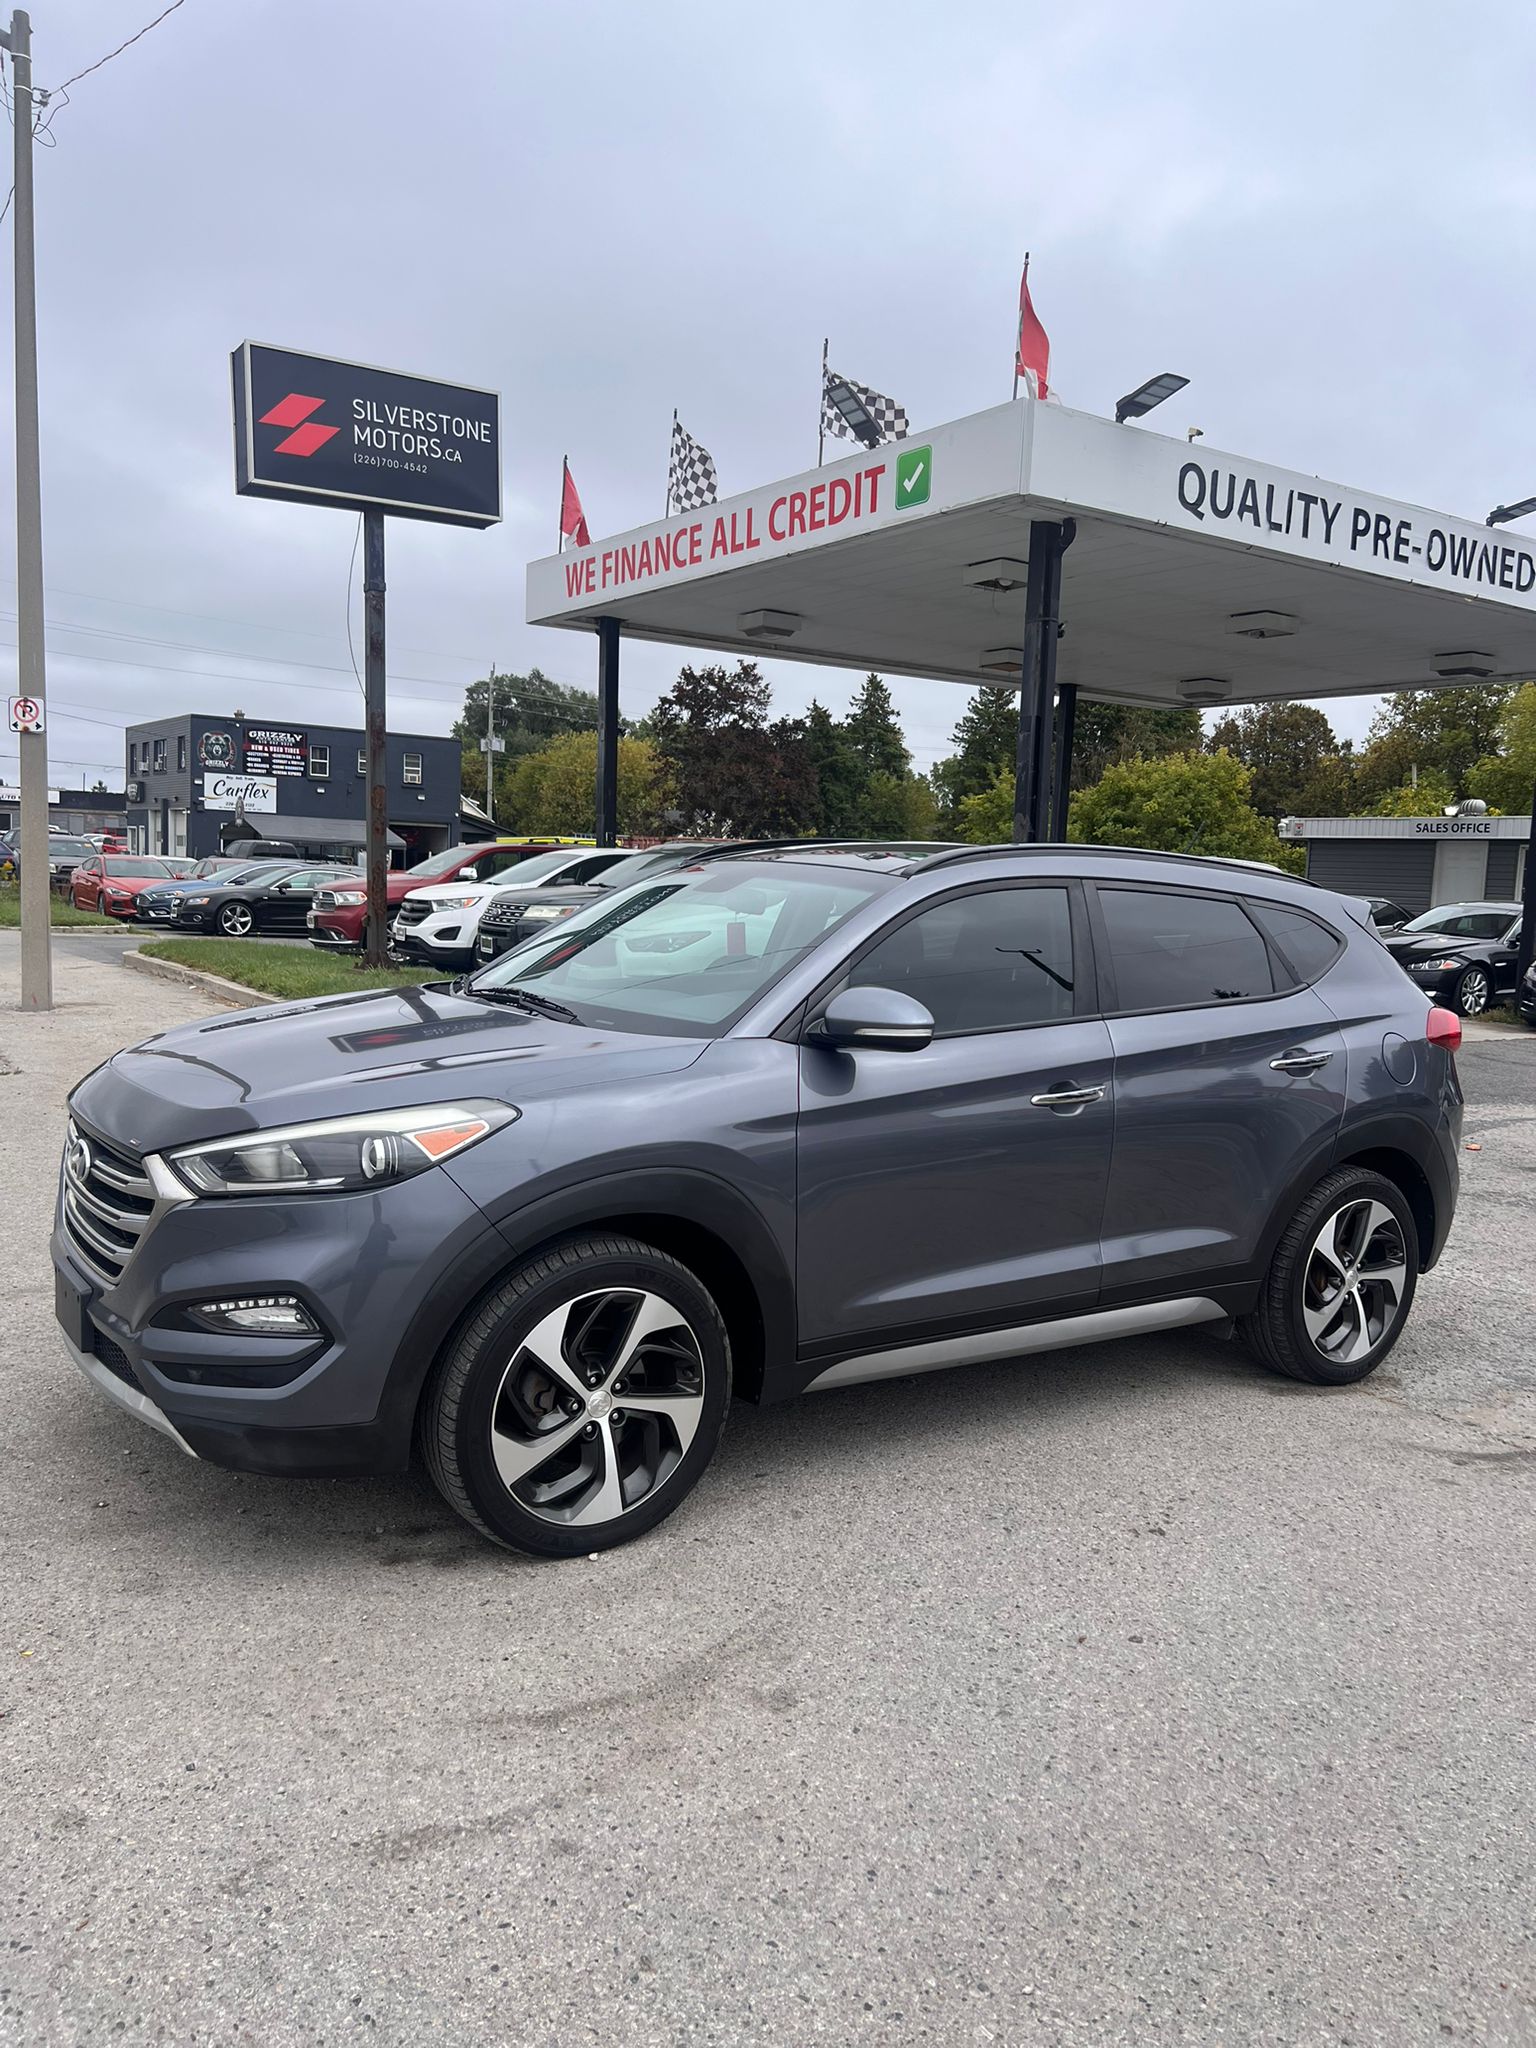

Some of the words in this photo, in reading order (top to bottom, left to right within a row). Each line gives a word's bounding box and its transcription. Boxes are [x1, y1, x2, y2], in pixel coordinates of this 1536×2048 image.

[352, 398, 491, 443] SILVERSTONE
[354, 424, 463, 463] MOTORS.CA
[565, 556, 596, 598] WE
[602, 523, 703, 589] FINANCE
[709, 507, 761, 559] ALL
[768, 464, 886, 541] CREDIT
[1178, 462, 1342, 544] QUALITY
[1350, 507, 1536, 593] PRE-OWNED
[248, 730, 303, 742] GRIZZLY
[213, 779, 269, 800] Carflex
[1415, 822, 1449, 833] SALES
[1451, 822, 1491, 833] OFFICE
